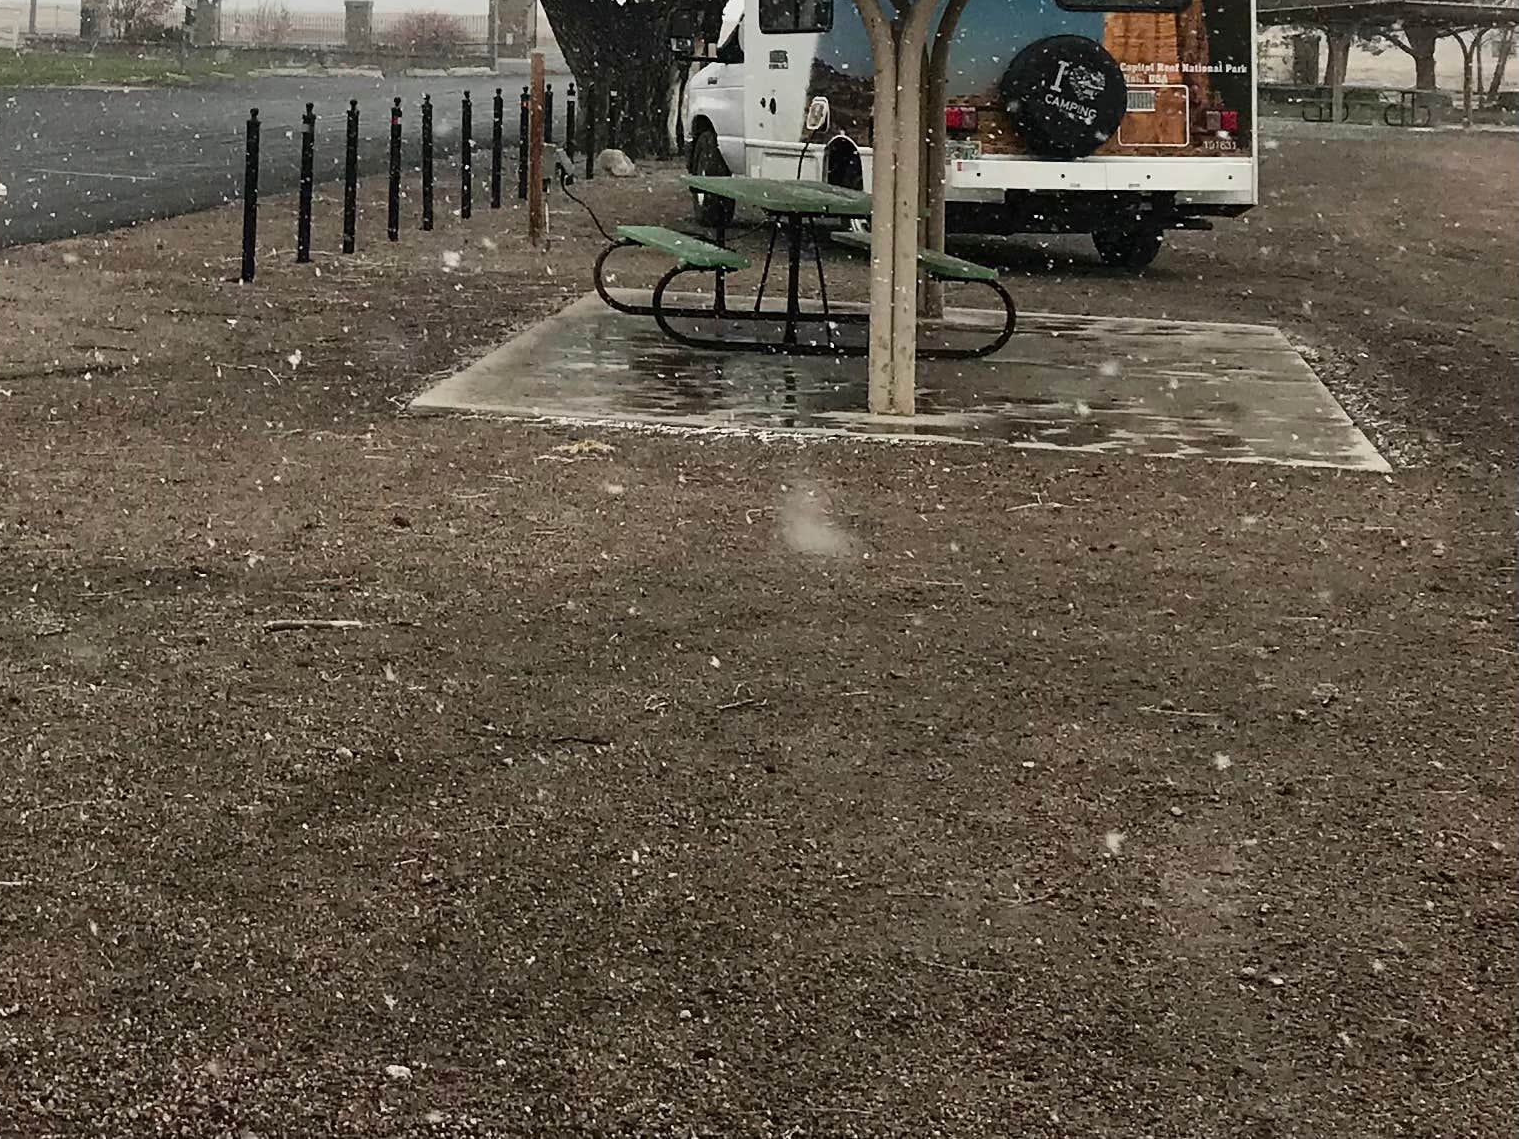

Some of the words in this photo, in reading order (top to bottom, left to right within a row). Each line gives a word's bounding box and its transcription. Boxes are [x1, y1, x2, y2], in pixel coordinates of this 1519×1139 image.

[1119, 62, 1155, 74] Capitol
[1157, 62, 1180, 73] Reef
[1182, 61, 1223, 73] National
[1225, 63, 1248, 74] Park
[1148, 74, 1169, 84] USA
[1044, 93, 1098, 120] CAMPING
